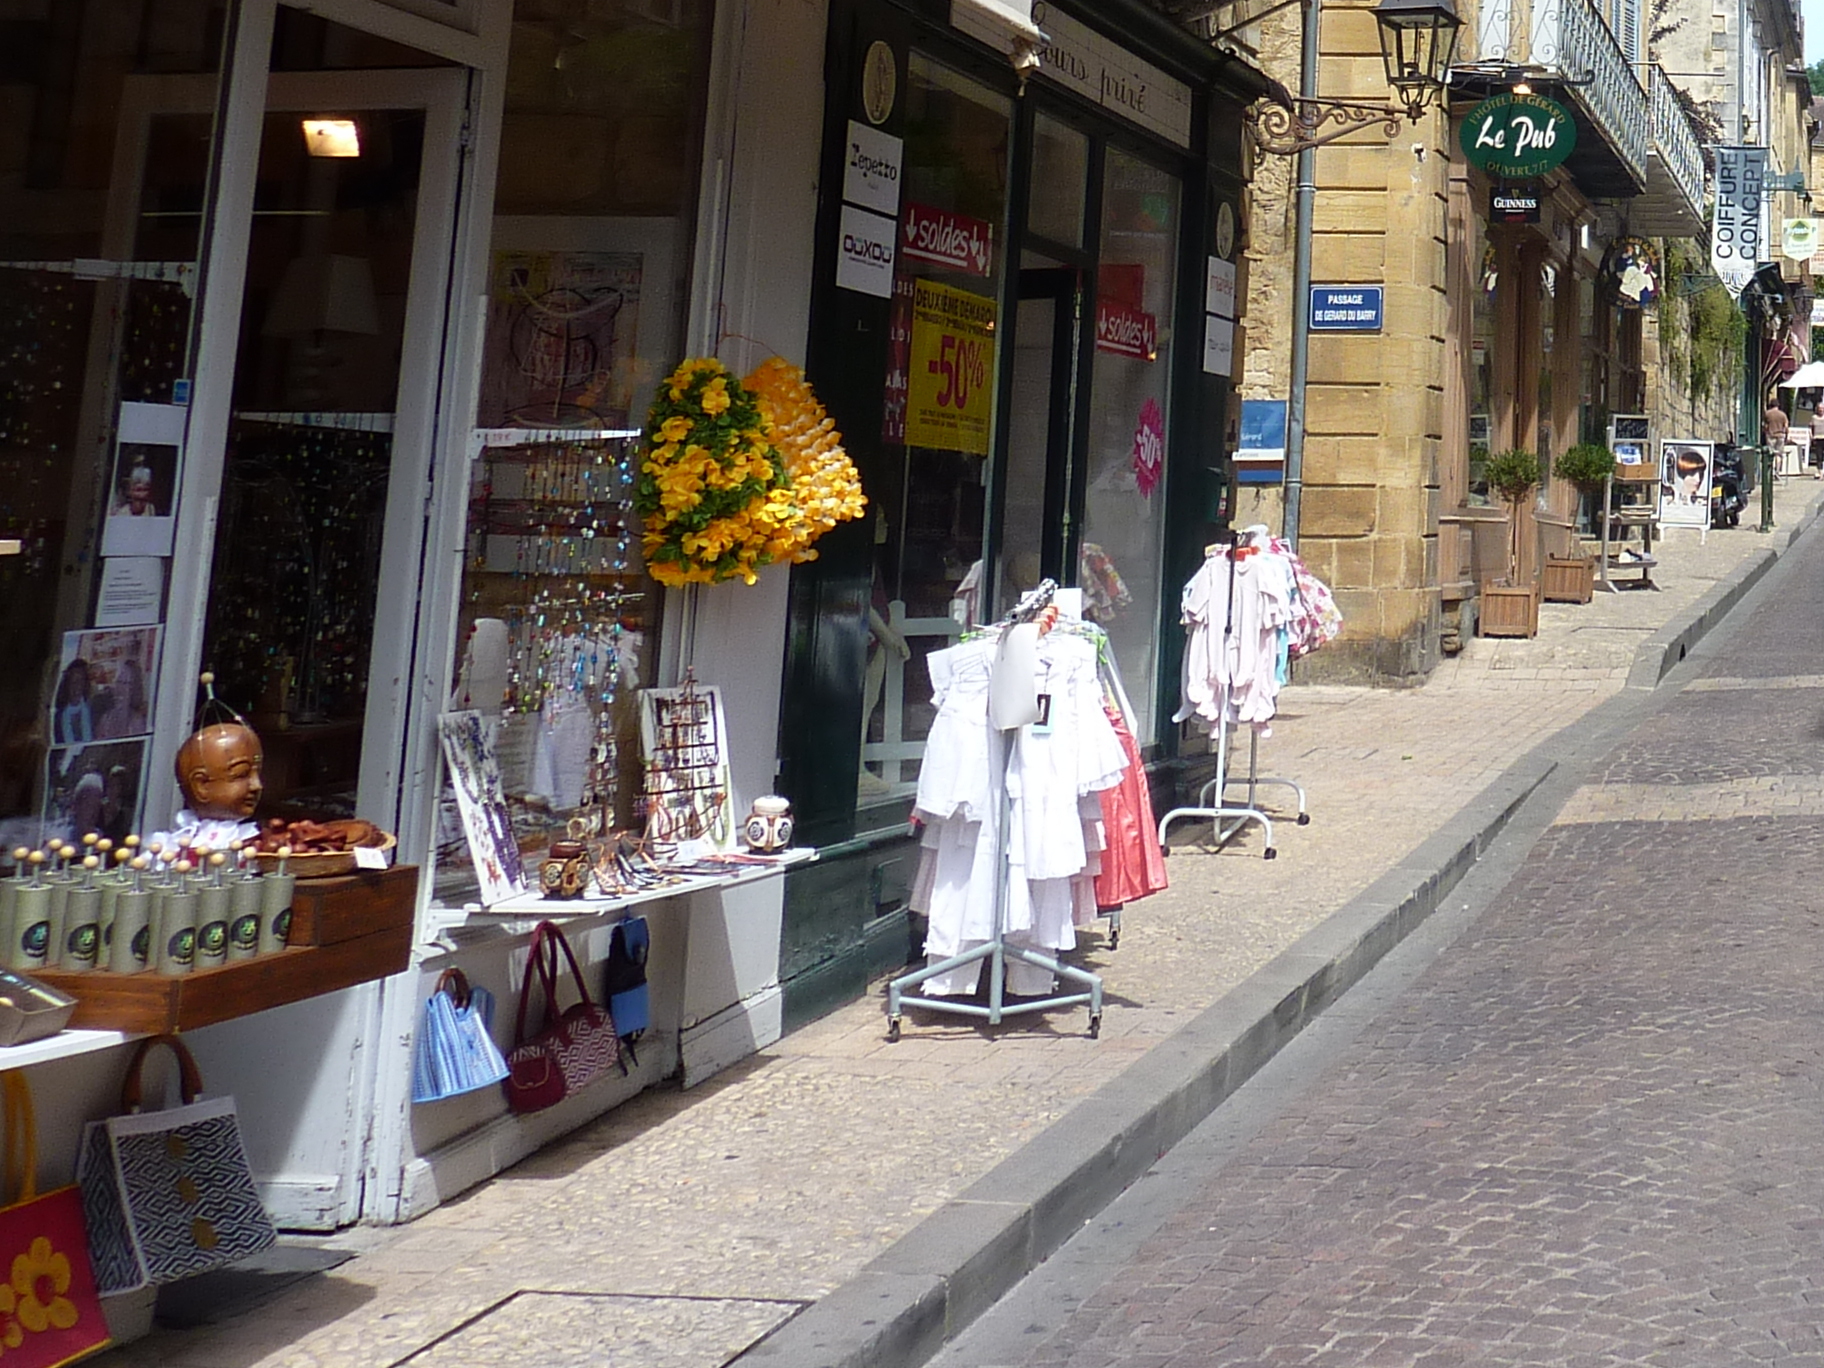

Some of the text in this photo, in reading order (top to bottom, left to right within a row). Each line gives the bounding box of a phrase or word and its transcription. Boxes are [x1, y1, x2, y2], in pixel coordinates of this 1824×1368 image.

[1101, 68, 1146, 113] privé
[1475, 115, 1556, 157] Le Pub
[1493, 197, 1537, 209] GUINNESS
[1716, 152, 1738, 259] COIFFURE
[1739, 154, 1761, 260] CONCEPT
[917, 215, 969, 258] soldes
[1327, 294, 1363, 305] PASSAGE
[1107, 312, 1142, 348] soldes
[928, 334, 985, 410] -50%
